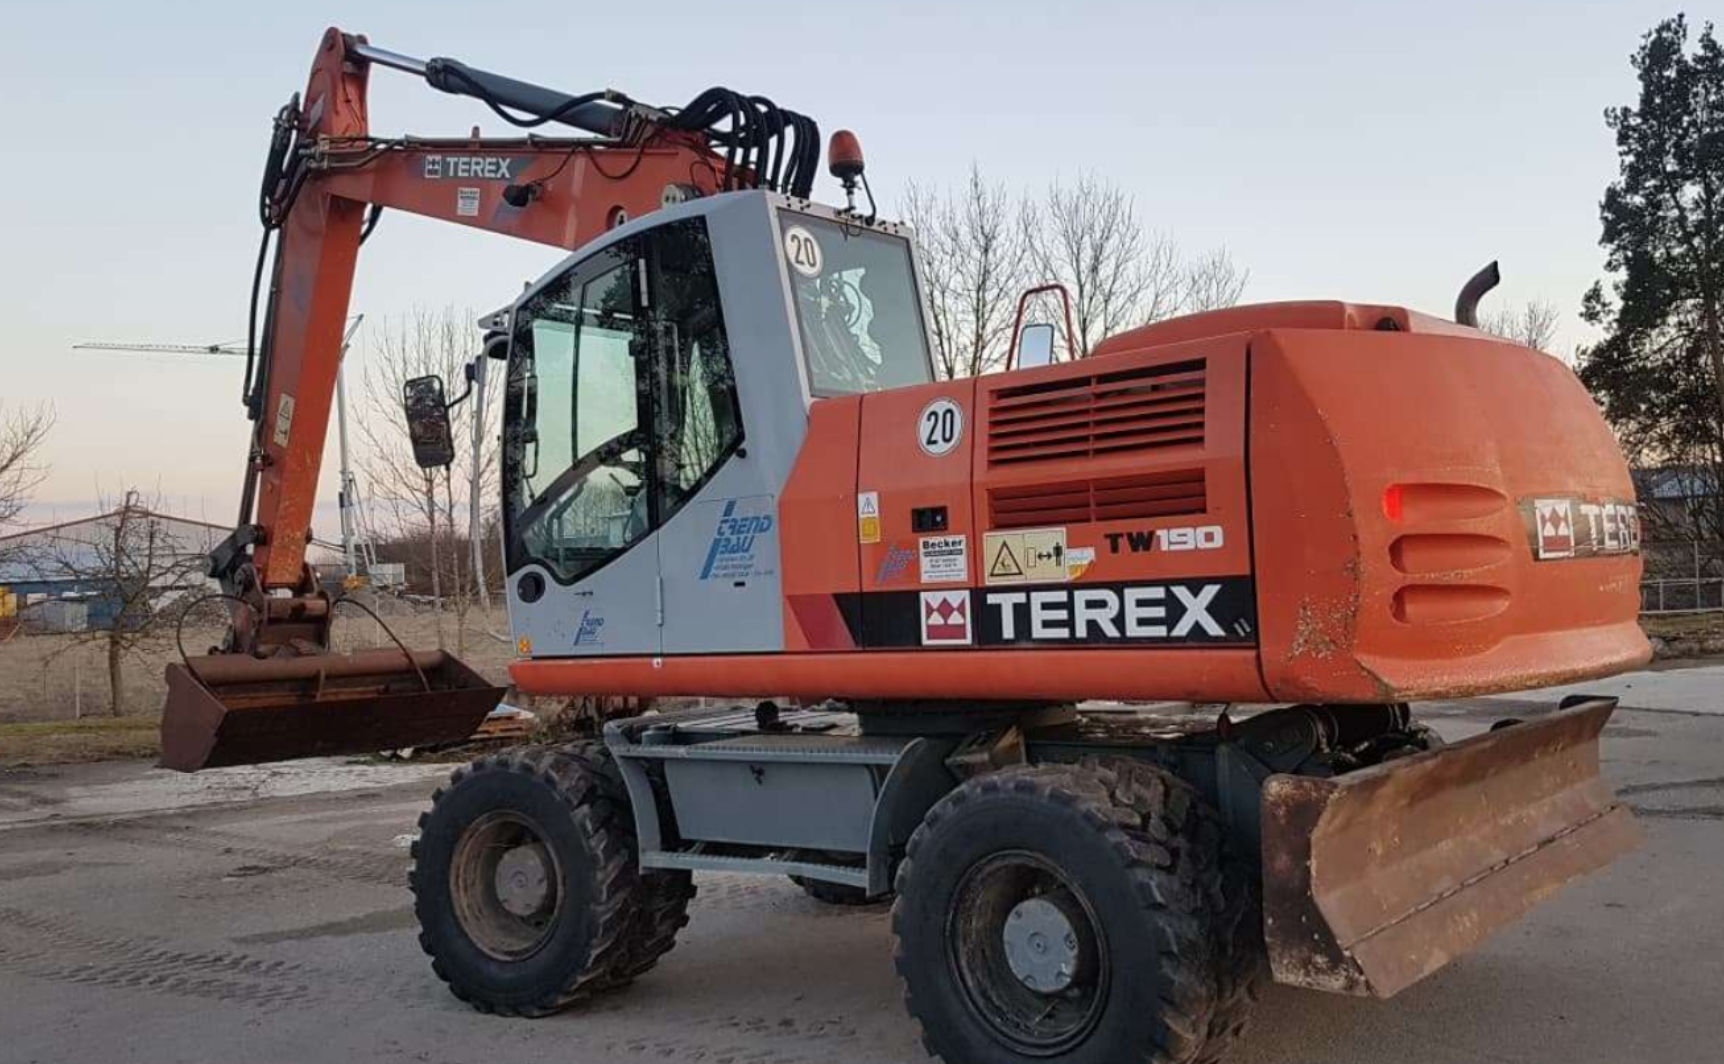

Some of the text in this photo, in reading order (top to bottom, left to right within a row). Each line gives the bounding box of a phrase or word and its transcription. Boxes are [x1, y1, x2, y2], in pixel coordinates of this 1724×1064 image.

[445, 157, 511, 178] TEREX
[790, 233, 817, 268] 20
[926, 408, 954, 445] 20
[922, 539, 963, 549] Becker
[1104, 525, 1223, 553] TW190
[986, 584, 1227, 640] TEREX
